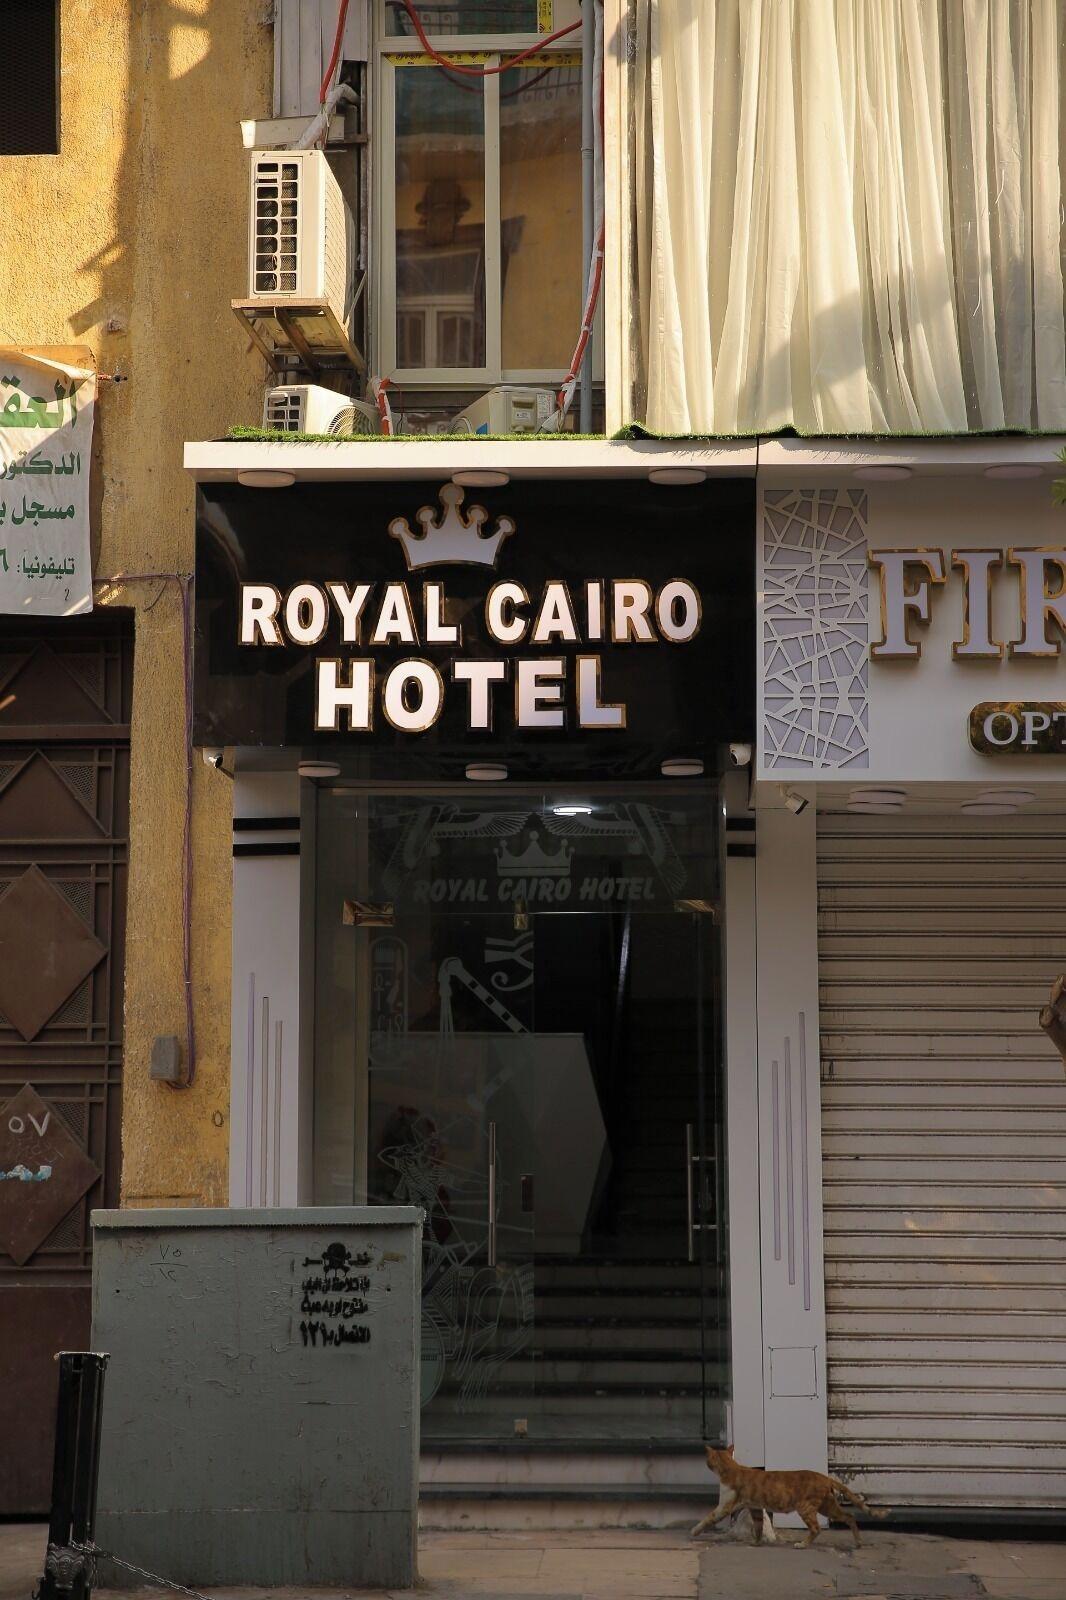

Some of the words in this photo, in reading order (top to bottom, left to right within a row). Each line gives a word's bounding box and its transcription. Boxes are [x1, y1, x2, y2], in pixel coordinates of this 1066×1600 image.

[12, 495, 75, 526] مسجل
[238, 580, 462, 647] ROYAL
[485, 577, 702, 645] CAIRO
[314, 655, 627, 732] HOTEL
[413, 878, 489, 901] ROYAL
[498, 877, 572, 901] CAIRO
[580, 877, 655, 900] HOTEL
